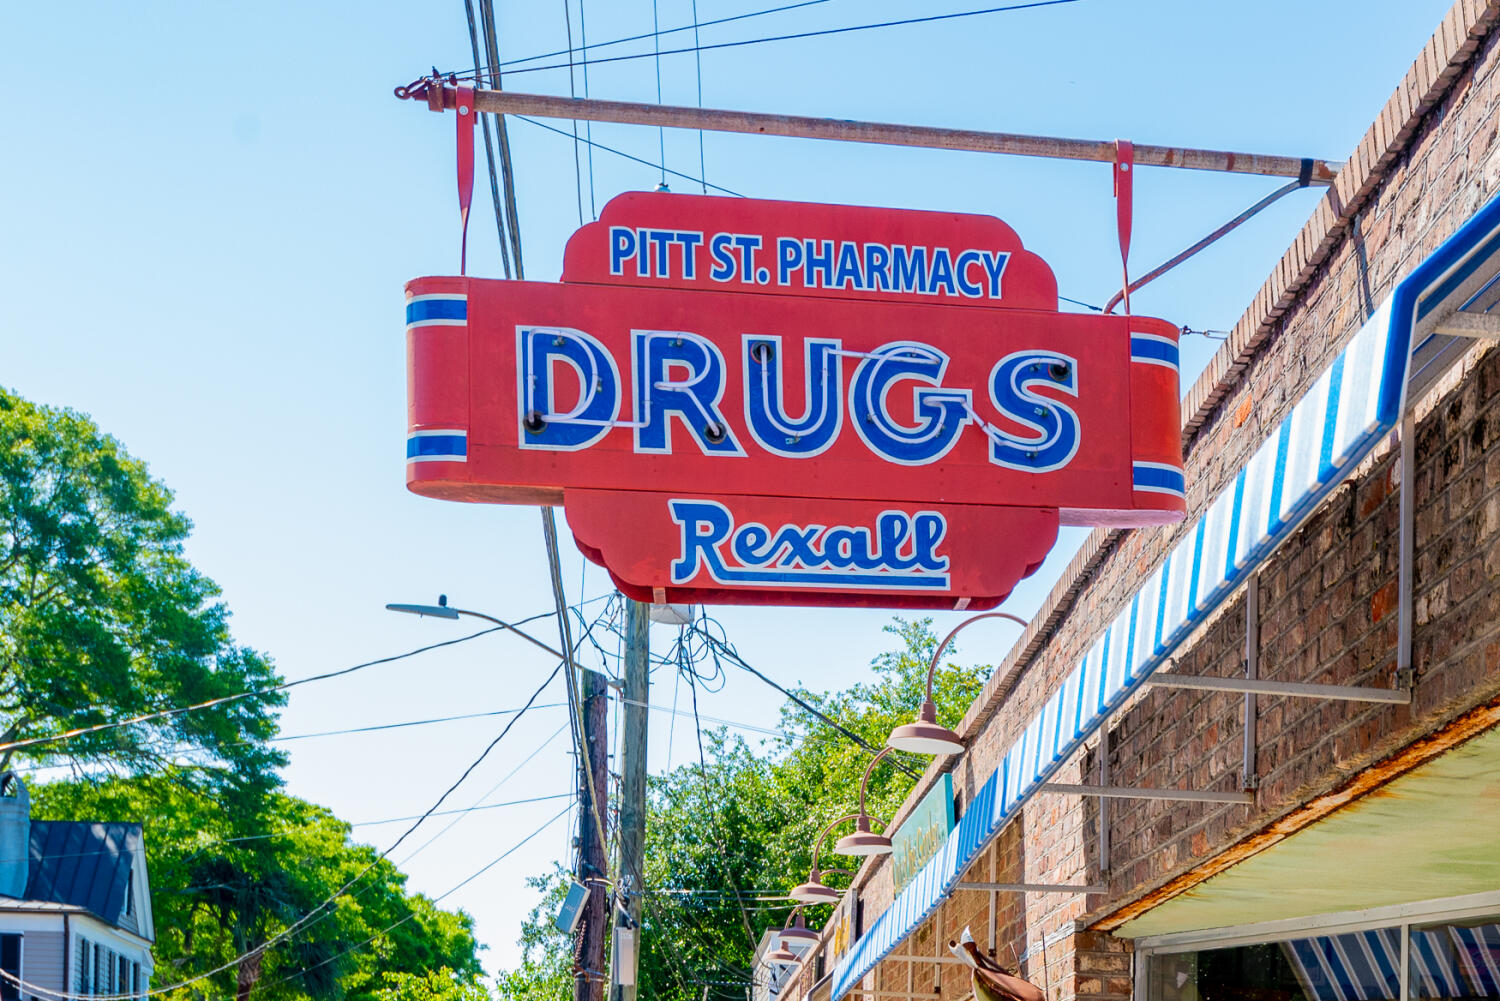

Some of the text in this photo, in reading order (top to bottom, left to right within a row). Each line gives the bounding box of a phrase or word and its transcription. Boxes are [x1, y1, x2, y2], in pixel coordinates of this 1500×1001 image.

[609, 226, 1011, 299] PITT ST. PHARMACY
[515, 324, 1079, 473] DRUGS
[669, 498, 950, 591] Rexall
